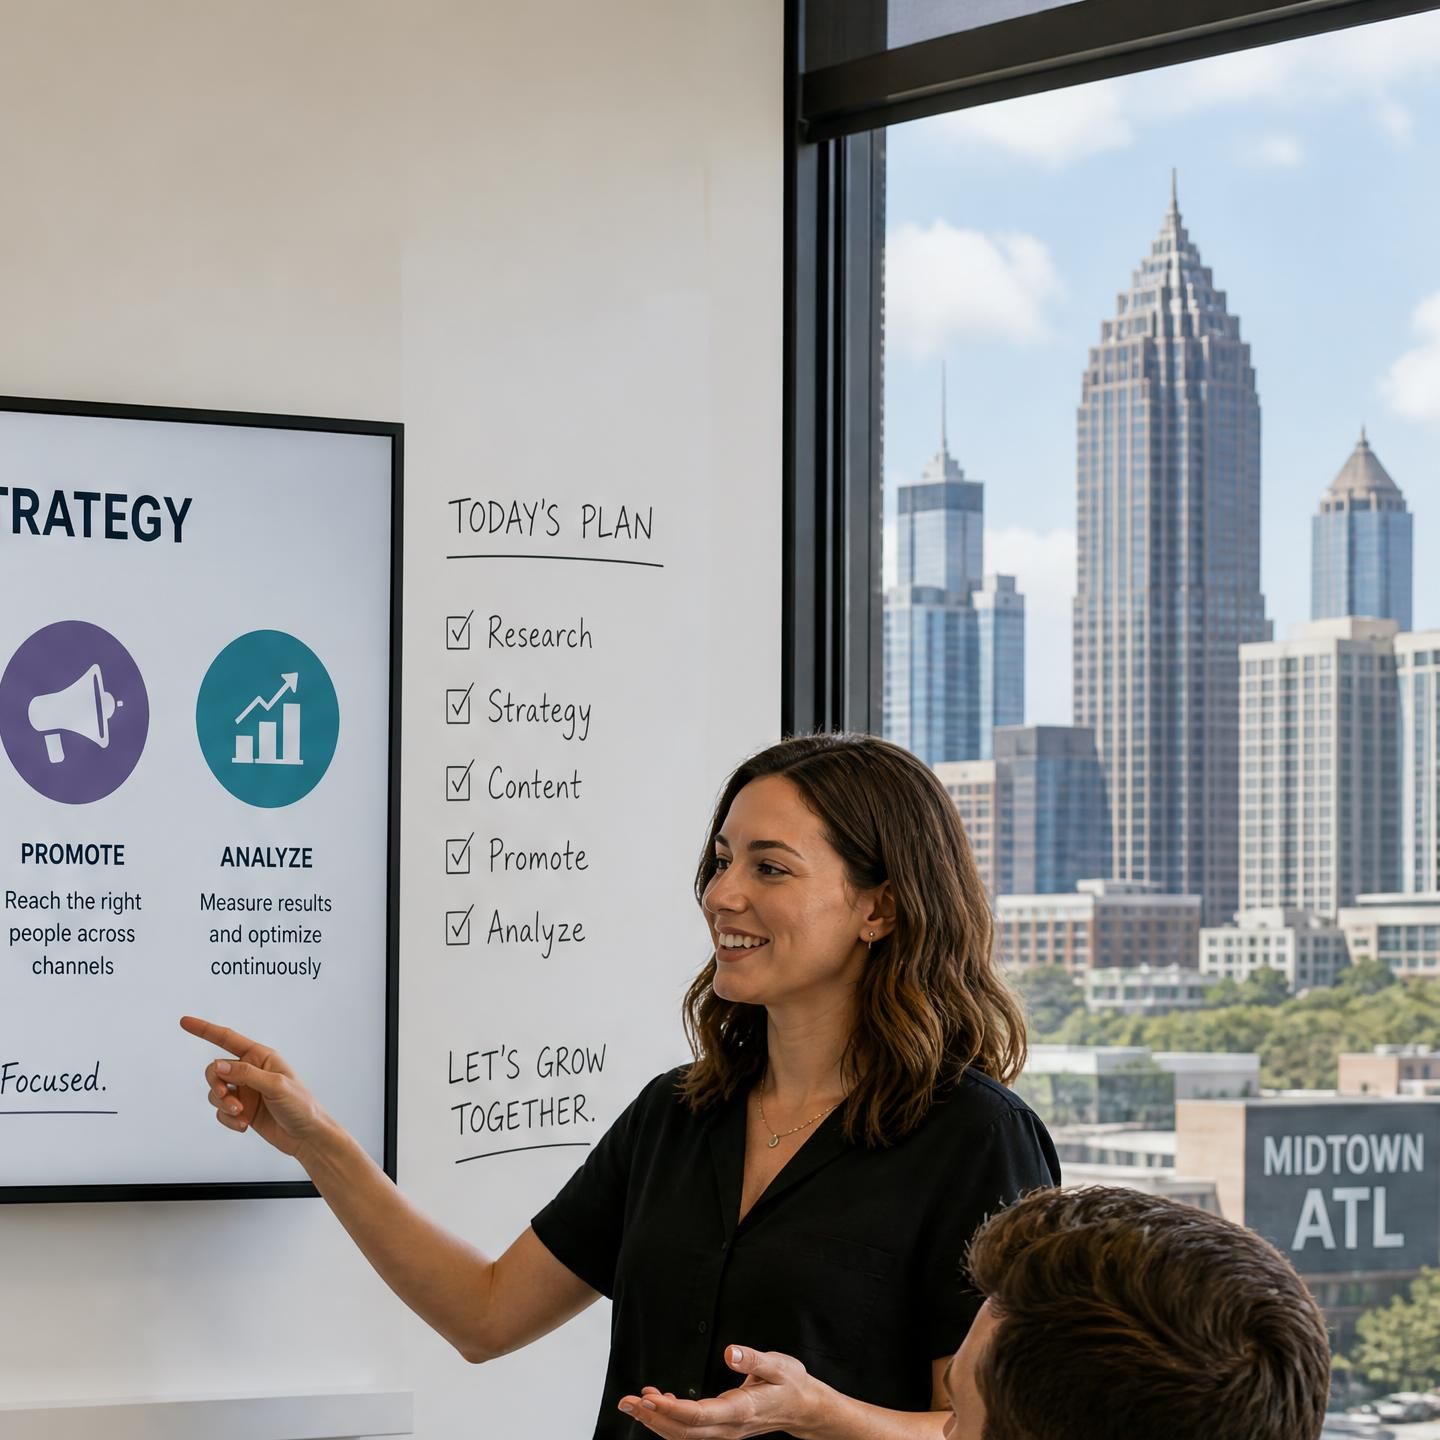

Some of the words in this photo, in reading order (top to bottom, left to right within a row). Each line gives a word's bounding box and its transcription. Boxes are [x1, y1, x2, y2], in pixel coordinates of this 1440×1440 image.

[449, 498, 559, 536] TODAY'S
[582, 504, 652, 539] PLAN
[489, 615, 592, 648] Research
[489, 689, 591, 741] Strategy
[489, 766, 582, 799] Content
[22, 843, 124, 865] PROMOTE
[221, 847, 312, 868] ANALYZE
[490, 838, 588, 872] Promote
[6, 891, 60, 909] Reach
[67, 891, 95, 909] the
[102, 892, 141, 915] right
[201, 893, 272, 911] Measure
[279, 894, 331, 911] results
[10, 923, 71, 946] people
[78, 929, 135, 942] across
[210, 925, 241, 942] and
[249, 927, 321, 948] optimize
[488, 910, 585, 959] Analyze
[33, 956, 113, 974] channels
[211, 957, 321, 979] continuously
[449, 1045, 519, 1084] LET'S
[537, 1044, 606, 1078] GROW
[451, 1094, 594, 1135] TOGETHER.
[1265, 1134, 1423, 1175] MIDTOWN
[1292, 1187, 1403, 1250] ATL
